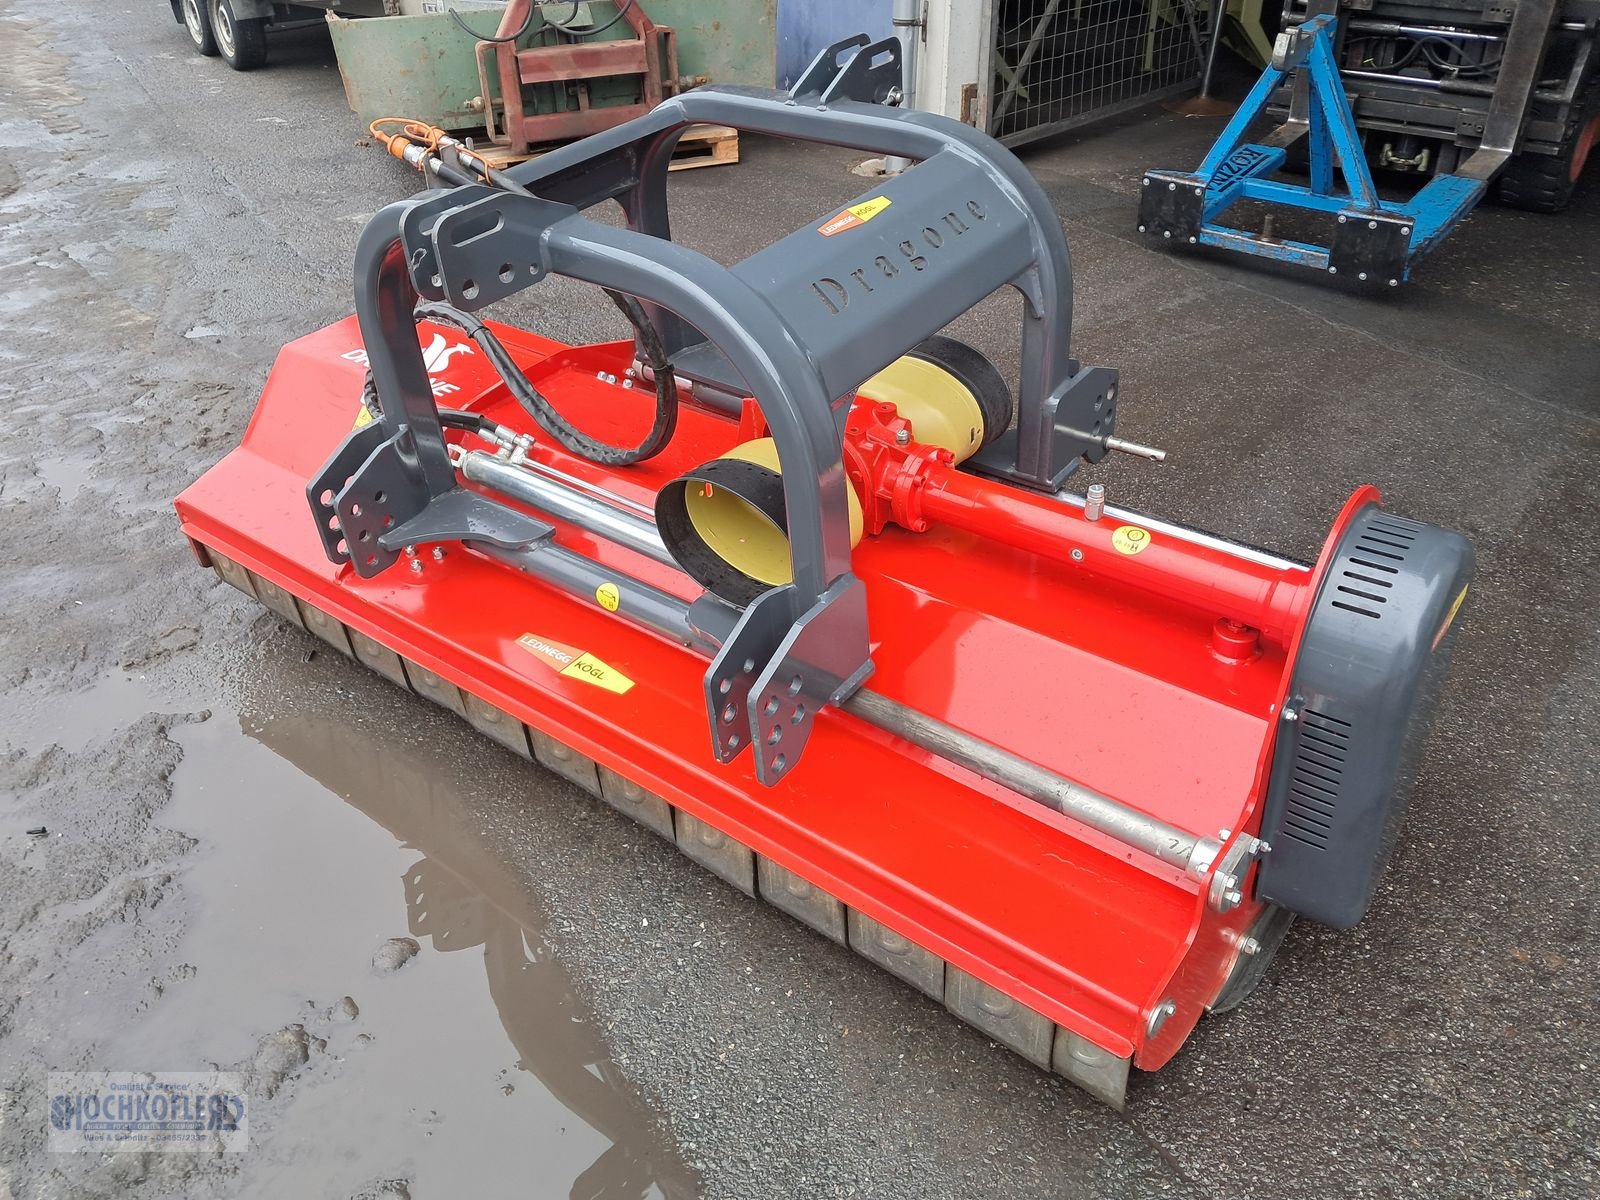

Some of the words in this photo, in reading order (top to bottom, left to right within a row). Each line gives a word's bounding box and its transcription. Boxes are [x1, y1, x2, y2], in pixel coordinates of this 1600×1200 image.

[810, 200, 988, 315] Dragone
[520, 635, 573, 664] LEDINEGG
[574, 661, 605, 680] KÖGL
